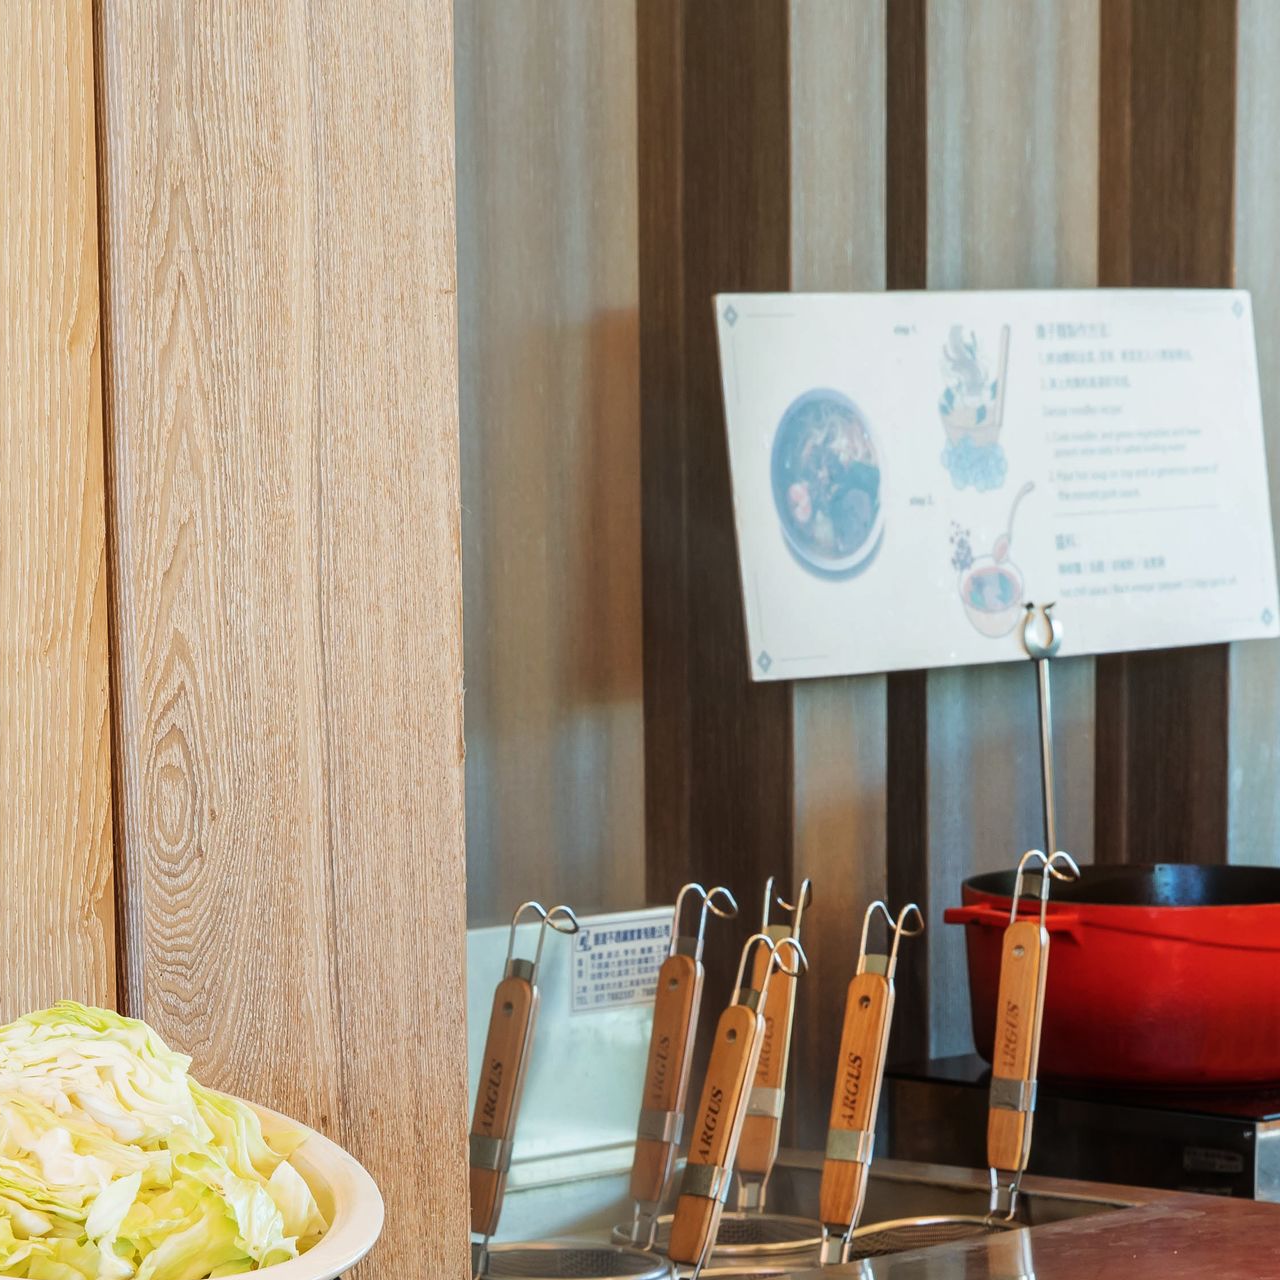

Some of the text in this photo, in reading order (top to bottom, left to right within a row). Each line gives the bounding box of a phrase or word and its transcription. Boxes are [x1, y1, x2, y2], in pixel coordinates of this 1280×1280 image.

[651, 1033, 671, 1106] ARGUS
[1001, 999, 1020, 1073] ARGUS
[479, 1058, 504, 1136] ARGUS
[696, 1085, 724, 1163] ARGUS
[841, 1051, 863, 1127] ARGUS
